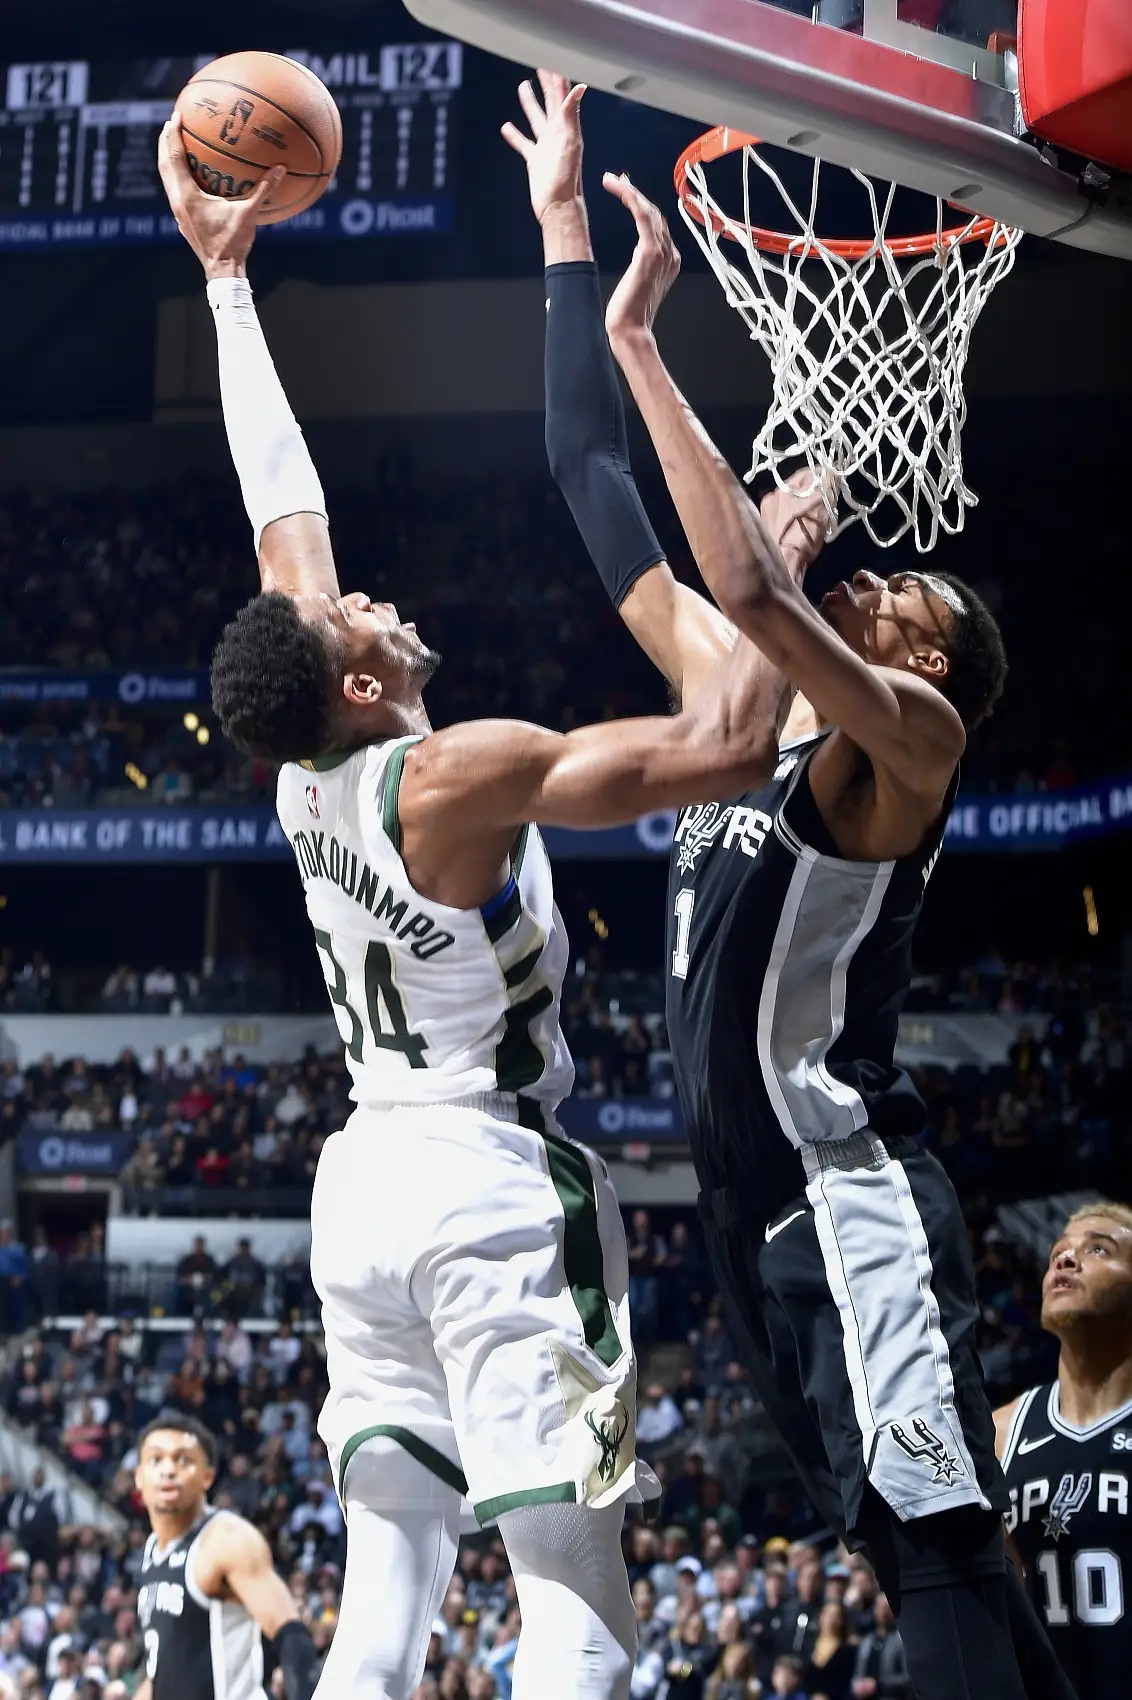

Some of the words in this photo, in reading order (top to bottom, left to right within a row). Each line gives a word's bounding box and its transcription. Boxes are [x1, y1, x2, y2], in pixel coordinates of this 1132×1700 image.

[311, 54, 379, 86] MIL
[398, 44, 449, 83] 124
[25, 69, 68, 107] 121
[15, 820, 87, 850] BANK
[97, 820, 131, 849] OF
[142, 819, 192, 848] THE
[202, 818, 256, 848] SAN
[945, 806, 980, 838] HE
[989, 797, 1104, 838] OFFICIAL
[672, 888, 695, 980] 1
[314, 926, 430, 1069] 34
[1037, 1550, 1124, 1626] 10
